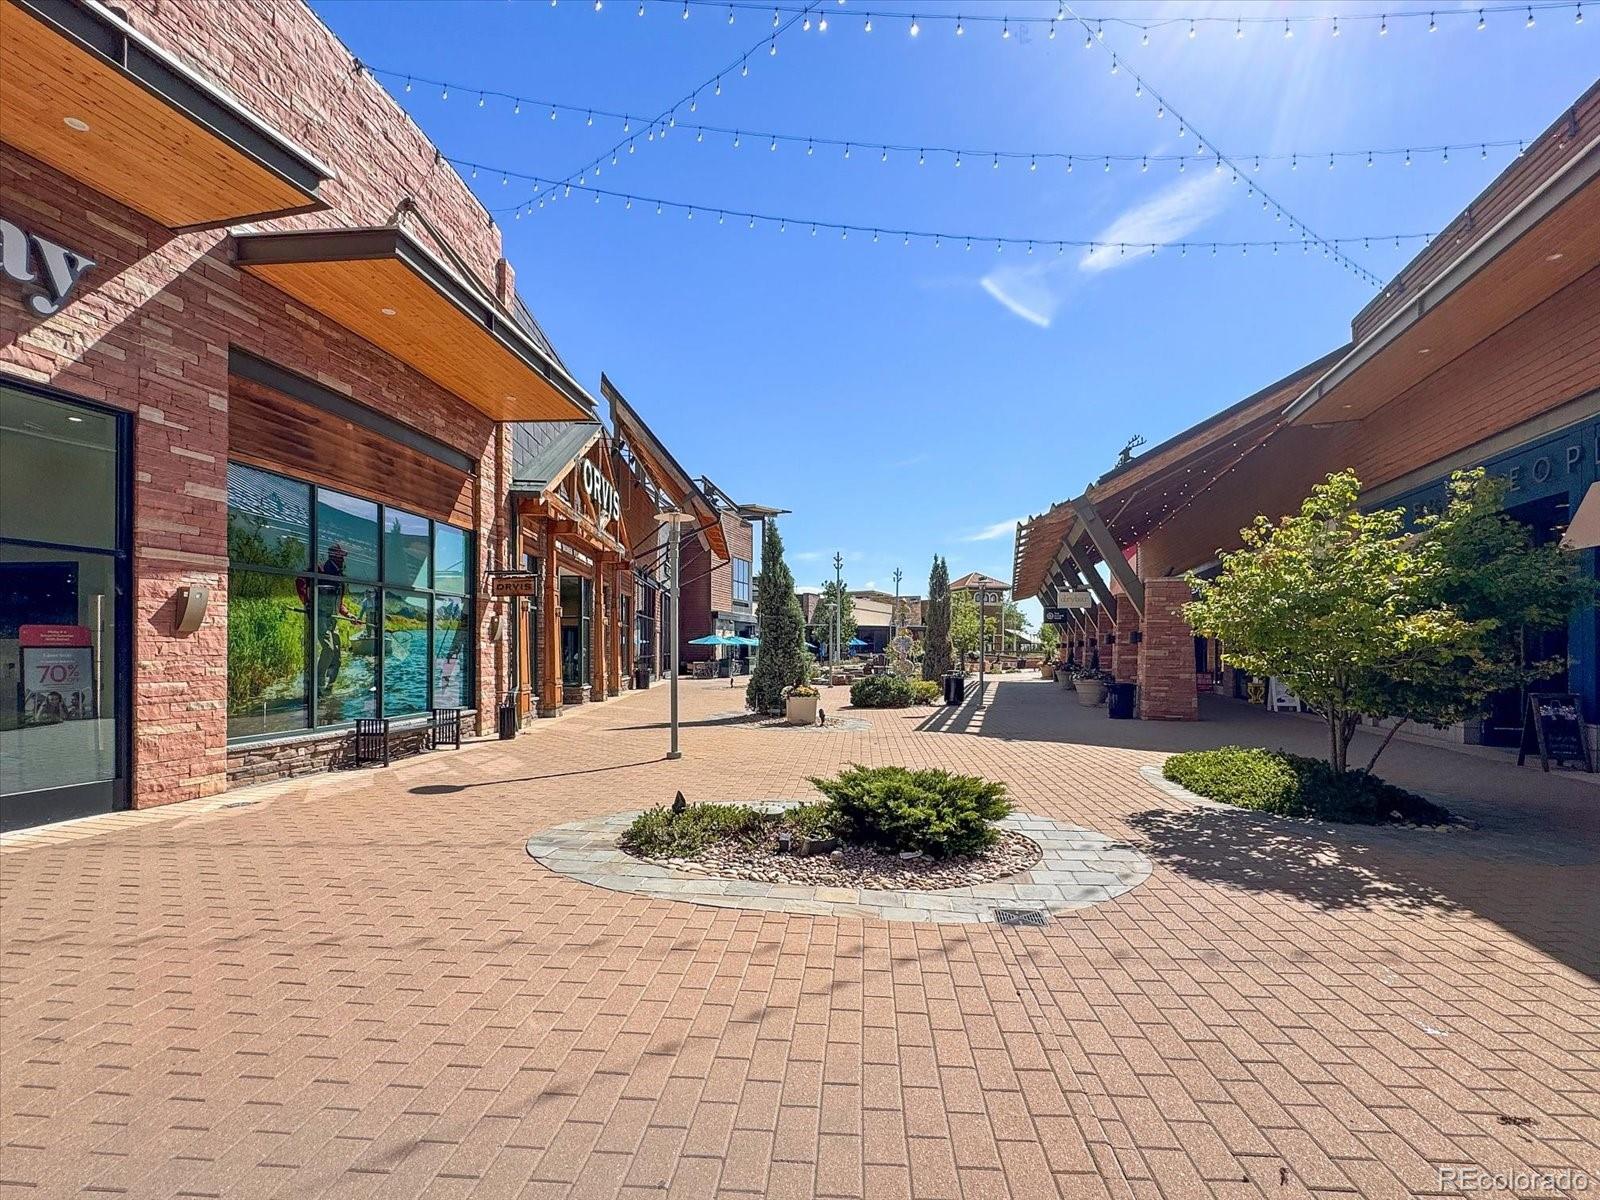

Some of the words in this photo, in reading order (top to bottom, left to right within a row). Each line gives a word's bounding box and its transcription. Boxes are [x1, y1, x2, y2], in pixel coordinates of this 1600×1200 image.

[583, 458, 620, 522] ORVIS
[496, 582, 533, 591] ORVIS
[36, 664, 80, 684] 70%
